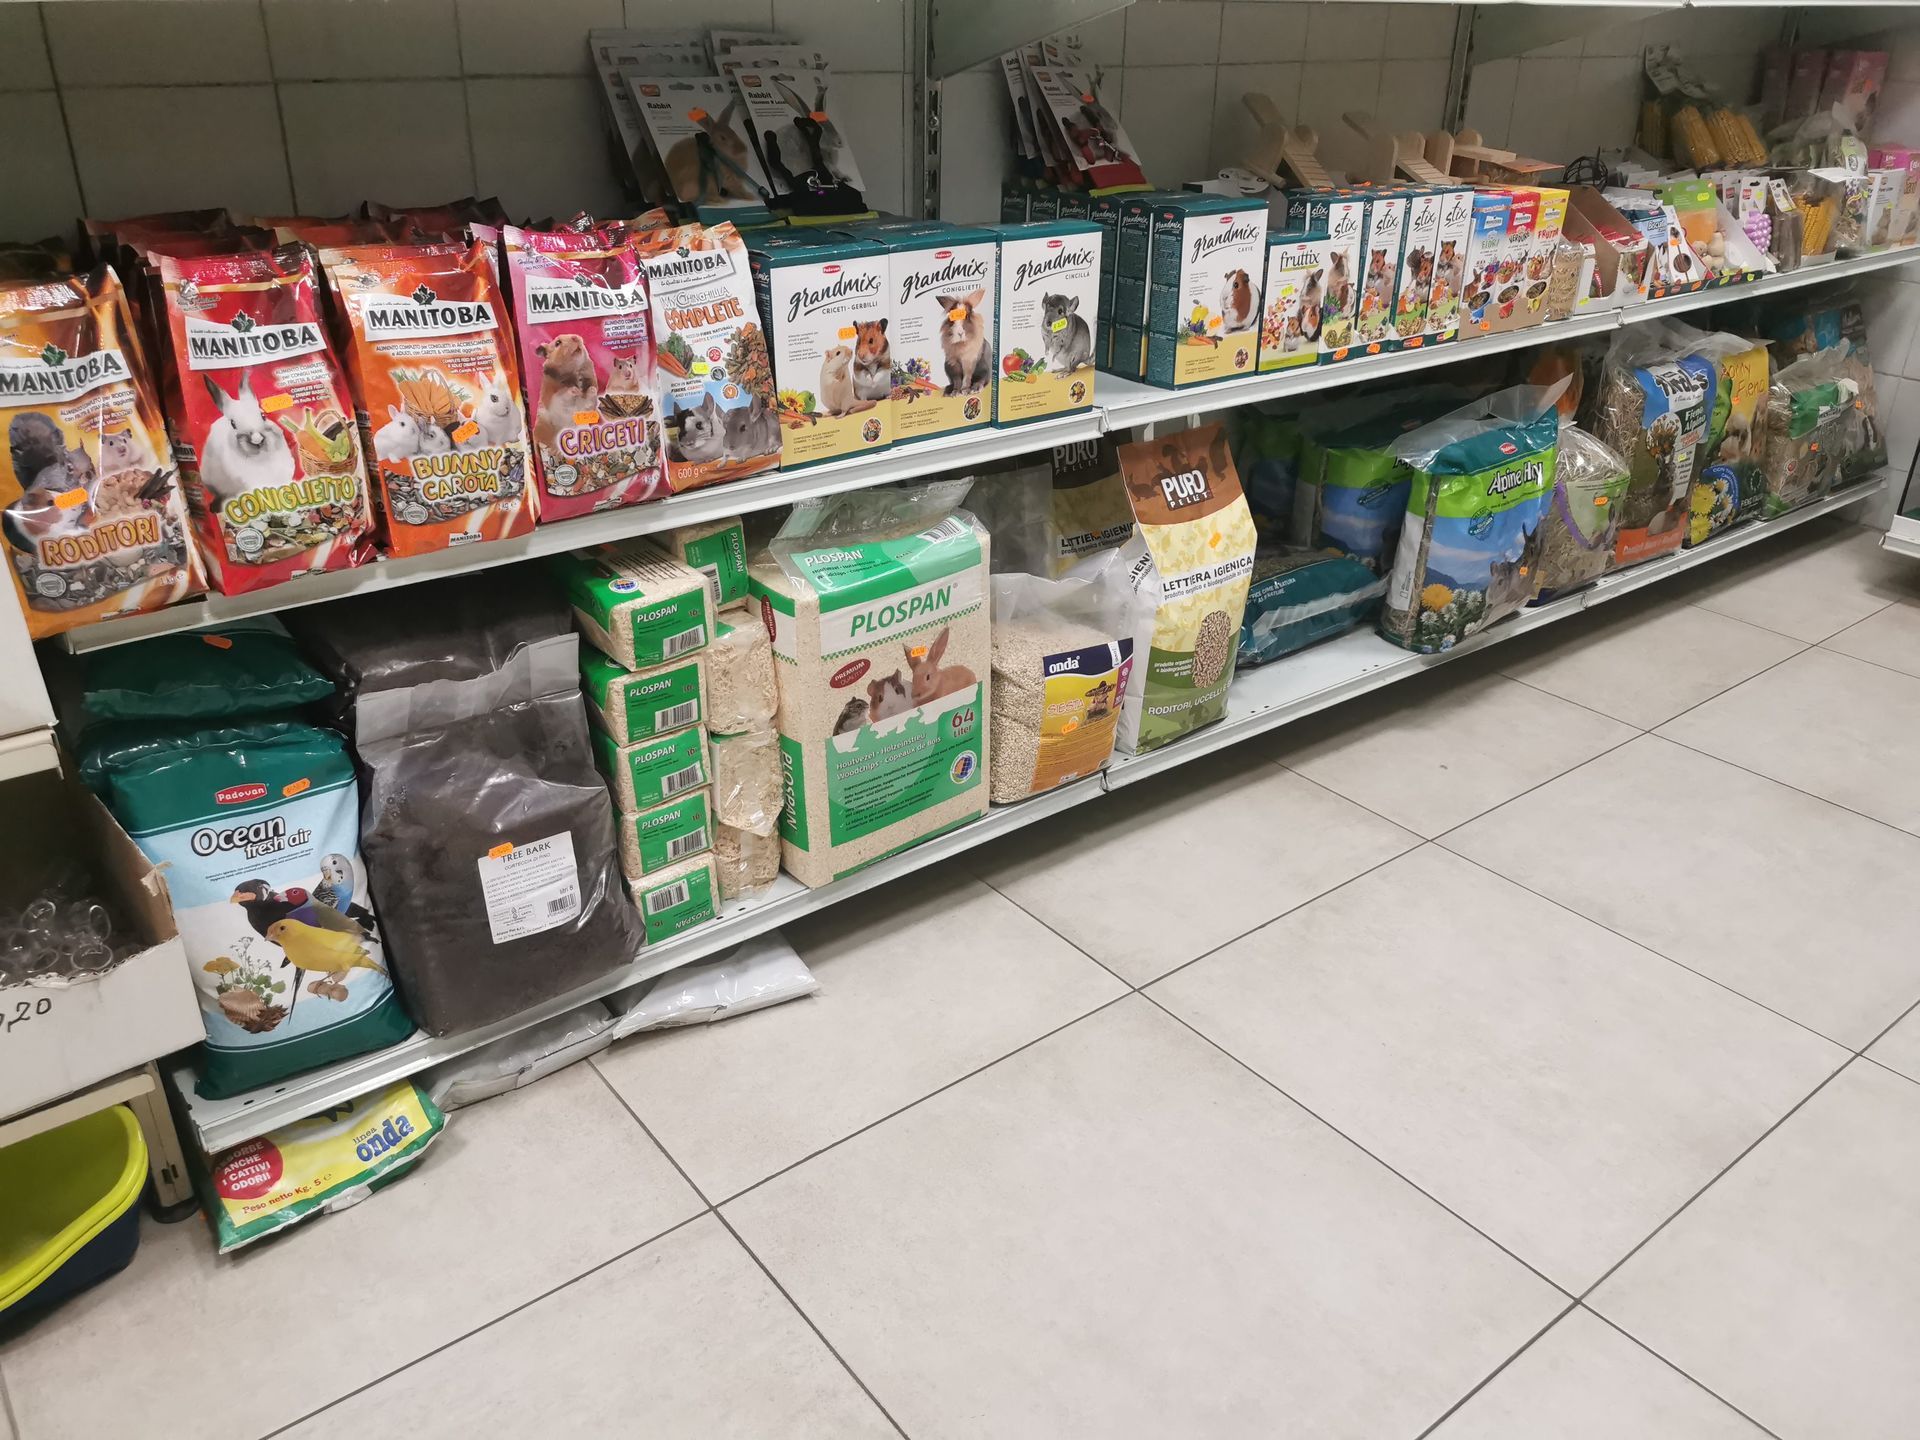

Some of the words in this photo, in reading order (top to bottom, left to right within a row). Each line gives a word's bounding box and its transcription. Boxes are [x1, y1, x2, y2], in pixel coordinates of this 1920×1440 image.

[1333, 212, 1358, 239] stix
[1375, 209, 1399, 235] stix
[1191, 222, 1260, 264] grandmix
[649, 254, 726, 278] MANITOBA
[1013, 247, 1094, 291] grandmix
[1280, 250, 1320, 272] fruttix
[900, 257, 987, 305] grandmix
[529, 289, 643, 311] MANITOBA
[787, 271, 880, 322] grandmix
[822, 306, 847, 314] CRICETI
[851, 302, 878, 311] GERBILLI
[369, 303, 491, 328] MANITOBA
[190, 325, 317, 357] MANITOBA
[0, 353, 122, 393] MANITOBA
[560, 418, 645, 456] CRICETI
[412, 449, 502, 480] BUNNY
[1053, 439, 1098, 468] PURO
[677, 468, 692, 479] 600
[1160, 469, 1205, 501] PURO
[1487, 468, 1523, 498] Alpine
[225, 475, 356, 525] CONIGLIETTO
[422, 473, 497, 501] CAROTA
[41, 515, 159, 567] RODITORI
[731, 532, 744, 572] PLOSPAN
[804, 549, 864, 567] PLOSPAN
[1213, 556, 1253, 578] IGIENICA
[637, 603, 678, 623] PLOSPAN
[850, 585, 952, 638] PLOSPAN
[834, 661, 865, 681] PREMIUM
[1049, 658, 1080, 674] onda
[630, 679, 672, 697] PLOSPAN
[951, 708, 974, 728] 64
[1148, 701, 1193, 715] RODITORI,
[635, 745, 675, 765] PLOSPAN
[217, 786, 265, 802] Padovan
[782, 750, 798, 830] PLOSPAN
[642, 810, 681, 830] PLOSPAN
[191, 816, 286, 857] Ocean
[244, 836, 286, 860] fresh
[288, 828, 312, 848] air
[502, 851, 524, 863] TREE
[526, 842, 552, 856] BARK
[675, 909, 711, 929] PLOSPAN
[353, 1127, 377, 1144] linea
[356, 1115, 415, 1162] onda
[224, 1153, 262, 1175] ANCHE
[229, 1161, 271, 1181] CATTIVI
[242, 1202, 267, 1214] Peso
[268, 1192, 294, 1205] netto
[294, 1184, 312, 1195] Kg.
[314, 1178, 322, 1187] 5
